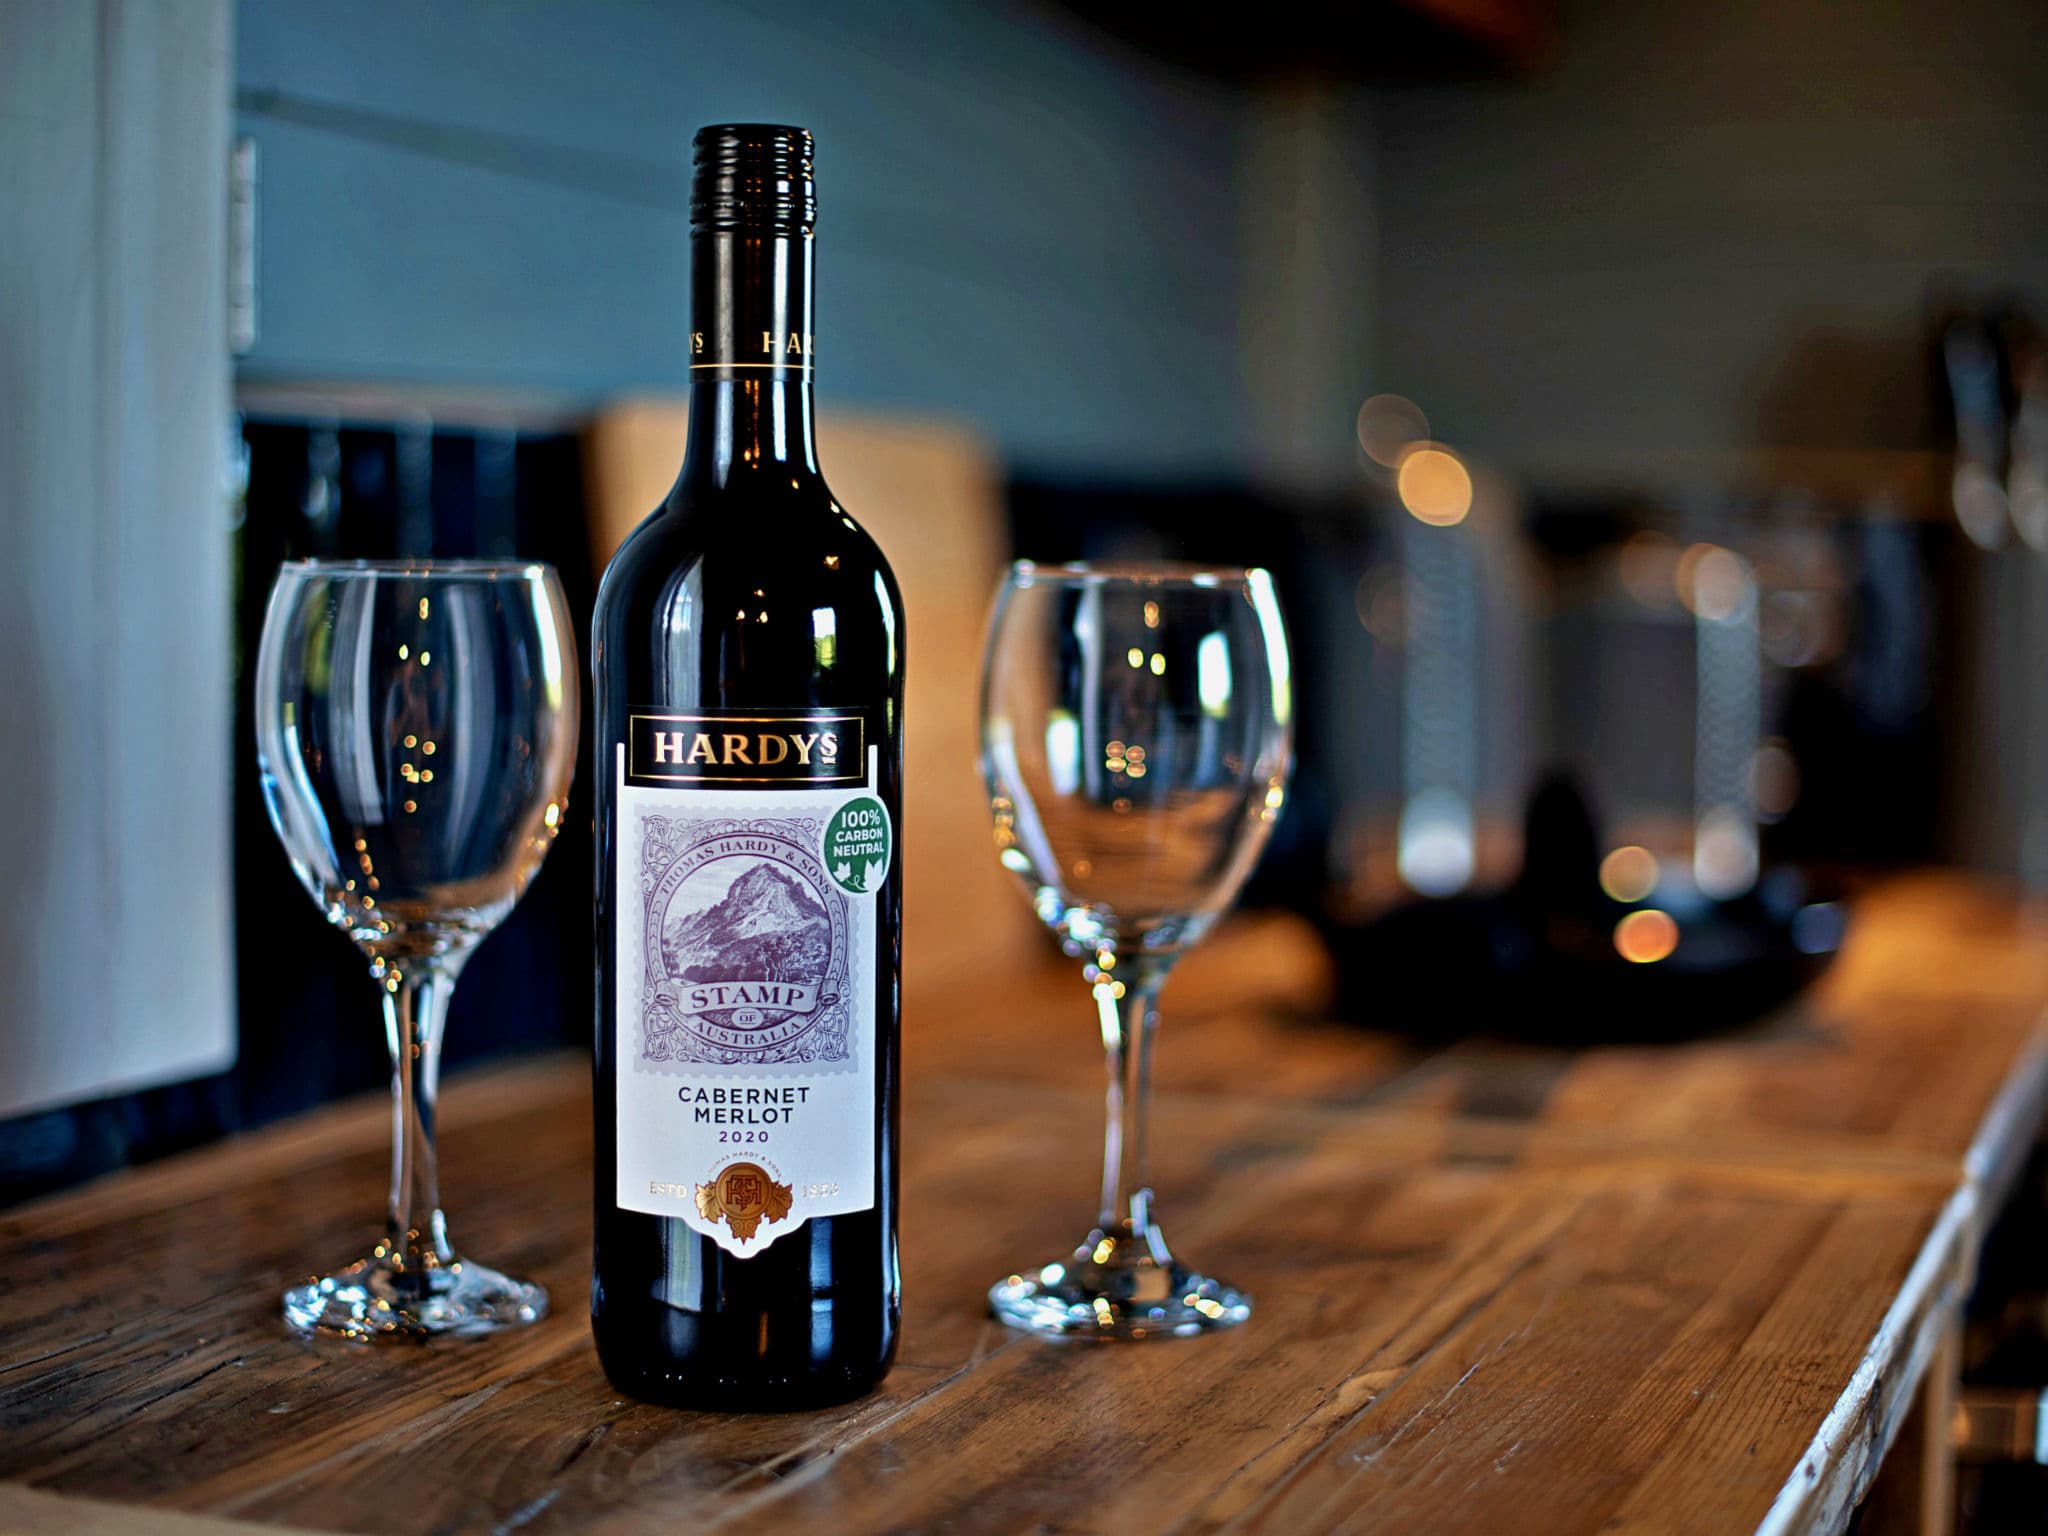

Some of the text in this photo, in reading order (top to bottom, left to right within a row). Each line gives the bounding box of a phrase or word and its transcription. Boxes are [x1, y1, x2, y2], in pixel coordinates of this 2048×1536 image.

[841, 808, 880, 828] 100%
[835, 828, 883, 842] CARBON
[833, 841, 884, 857] NEUTRAL
[661, 840, 832, 896] THOMAS HARDY & SONS
[691, 986, 805, 1009] STAMP
[739, 1014, 756, 1022] OF
[694, 1020, 801, 1045] AUSTRALIA
[678, 1086, 810, 1104] CABERNET
[695, 1107, 793, 1124] MERLOT
[719, 1131, 768, 1143] 2020
